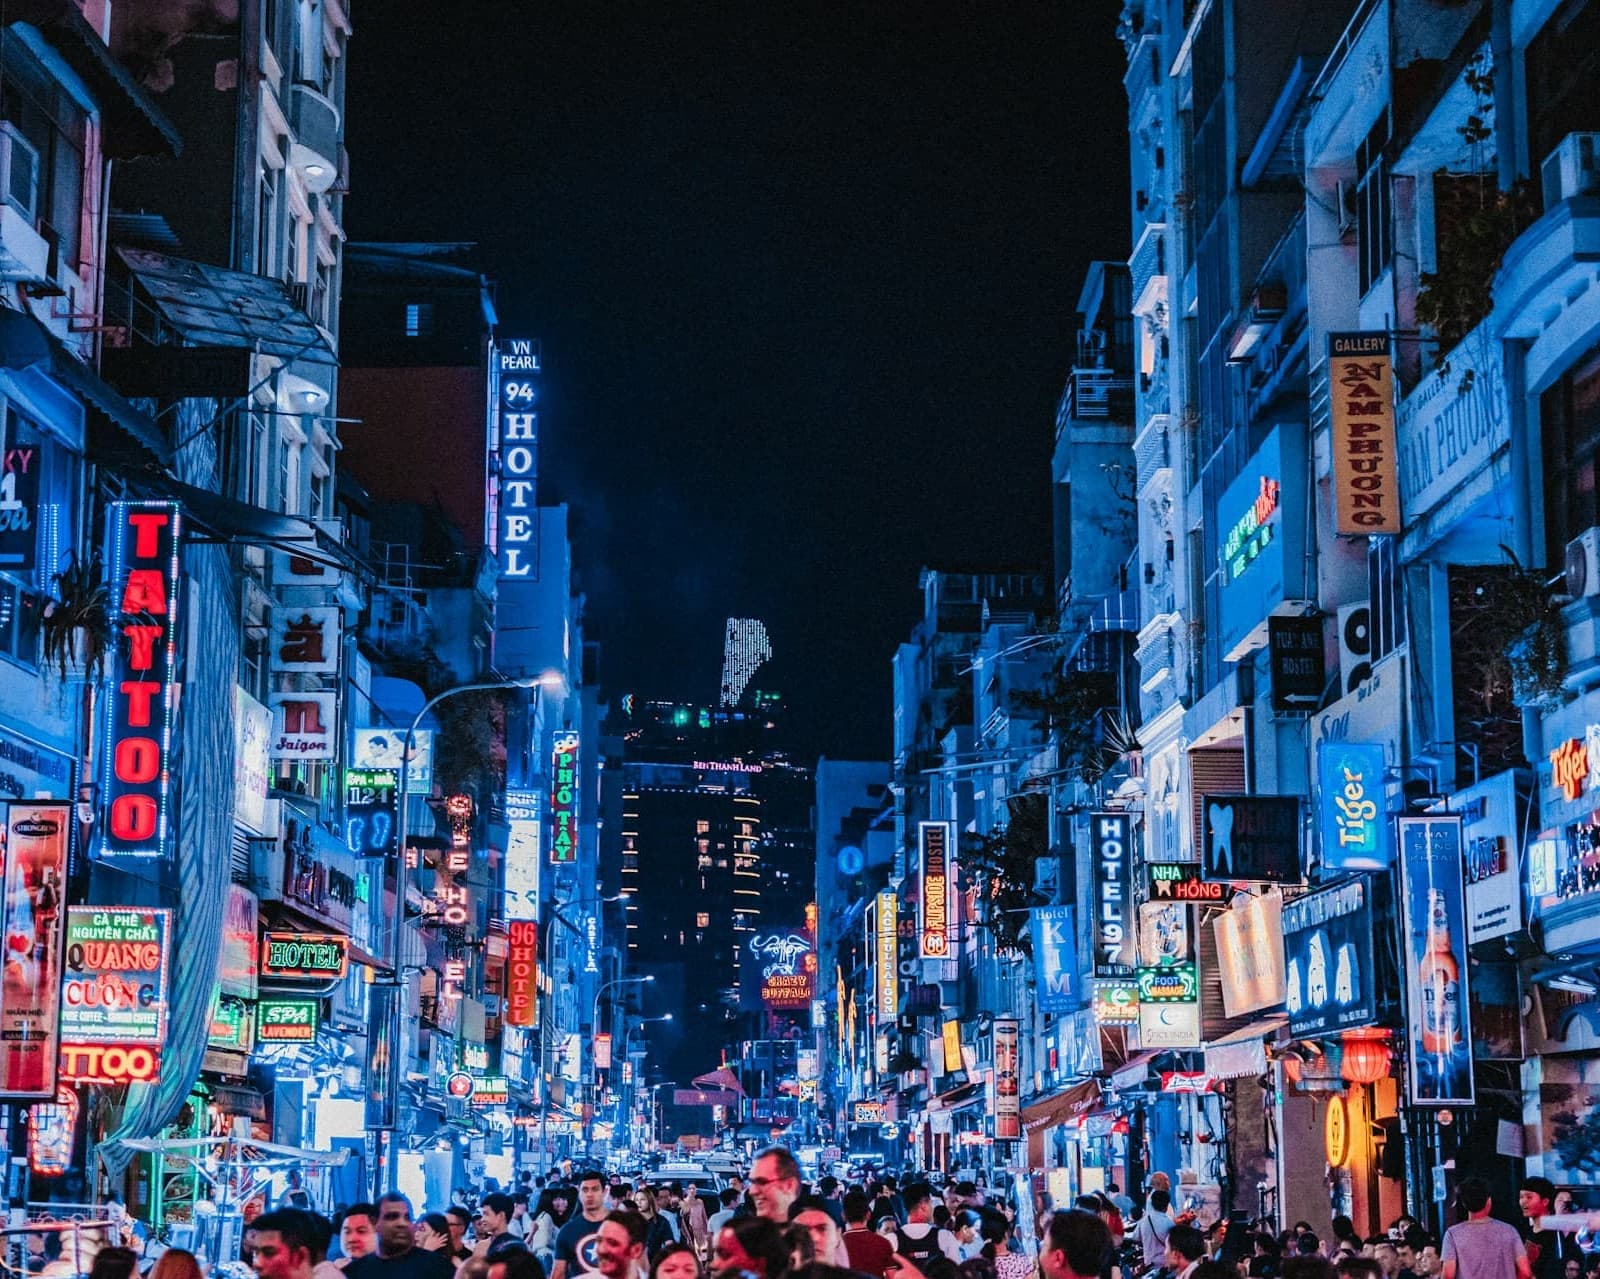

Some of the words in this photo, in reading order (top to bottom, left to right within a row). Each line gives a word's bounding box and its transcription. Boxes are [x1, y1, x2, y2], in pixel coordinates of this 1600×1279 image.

[512, 341, 530, 354] VN
[1335, 338, 1386, 352] GALLERY
[502, 356, 539, 369] PEARL
[505, 383, 534, 401] 94
[505, 414, 536, 576] HOTEL
[111, 514, 168, 841] TATTOO
[276, 737, 327, 753] Saigon
[710, 761, 740, 771] THANH
[740, 762, 762, 773] LAND
[1550, 738, 1588, 803] Tiger
[1335, 766, 1376, 848] Tiger
[927, 827, 944, 873] HOSTEL
[1101, 819, 1123, 921] HOTEL
[1152, 866, 1182, 880] NHA
[93, 913, 109, 926] CÀ
[114, 913, 139, 926] PHÊ
[1035, 908, 1068, 920] Hotel
[72, 926, 121, 940] NGUYÊN
[125, 925, 158, 940] CHẤT
[444, 887, 467, 1000] HOEL
[510, 923, 535, 945] 96
[1103, 924, 1123, 963] 97
[68, 942, 160, 972] QUANG
[269, 942, 342, 969] HOTEL
[1042, 922, 1072, 997] KIM
[511, 949, 531, 1023] HOTEL
[768, 976, 807, 986] CRAZY
[883, 962, 895, 1013] SAIGON
[899, 943, 914, 1027] HOTL
[1154, 977, 1179, 986] FOOT
[266, 1007, 308, 1023] SPA
